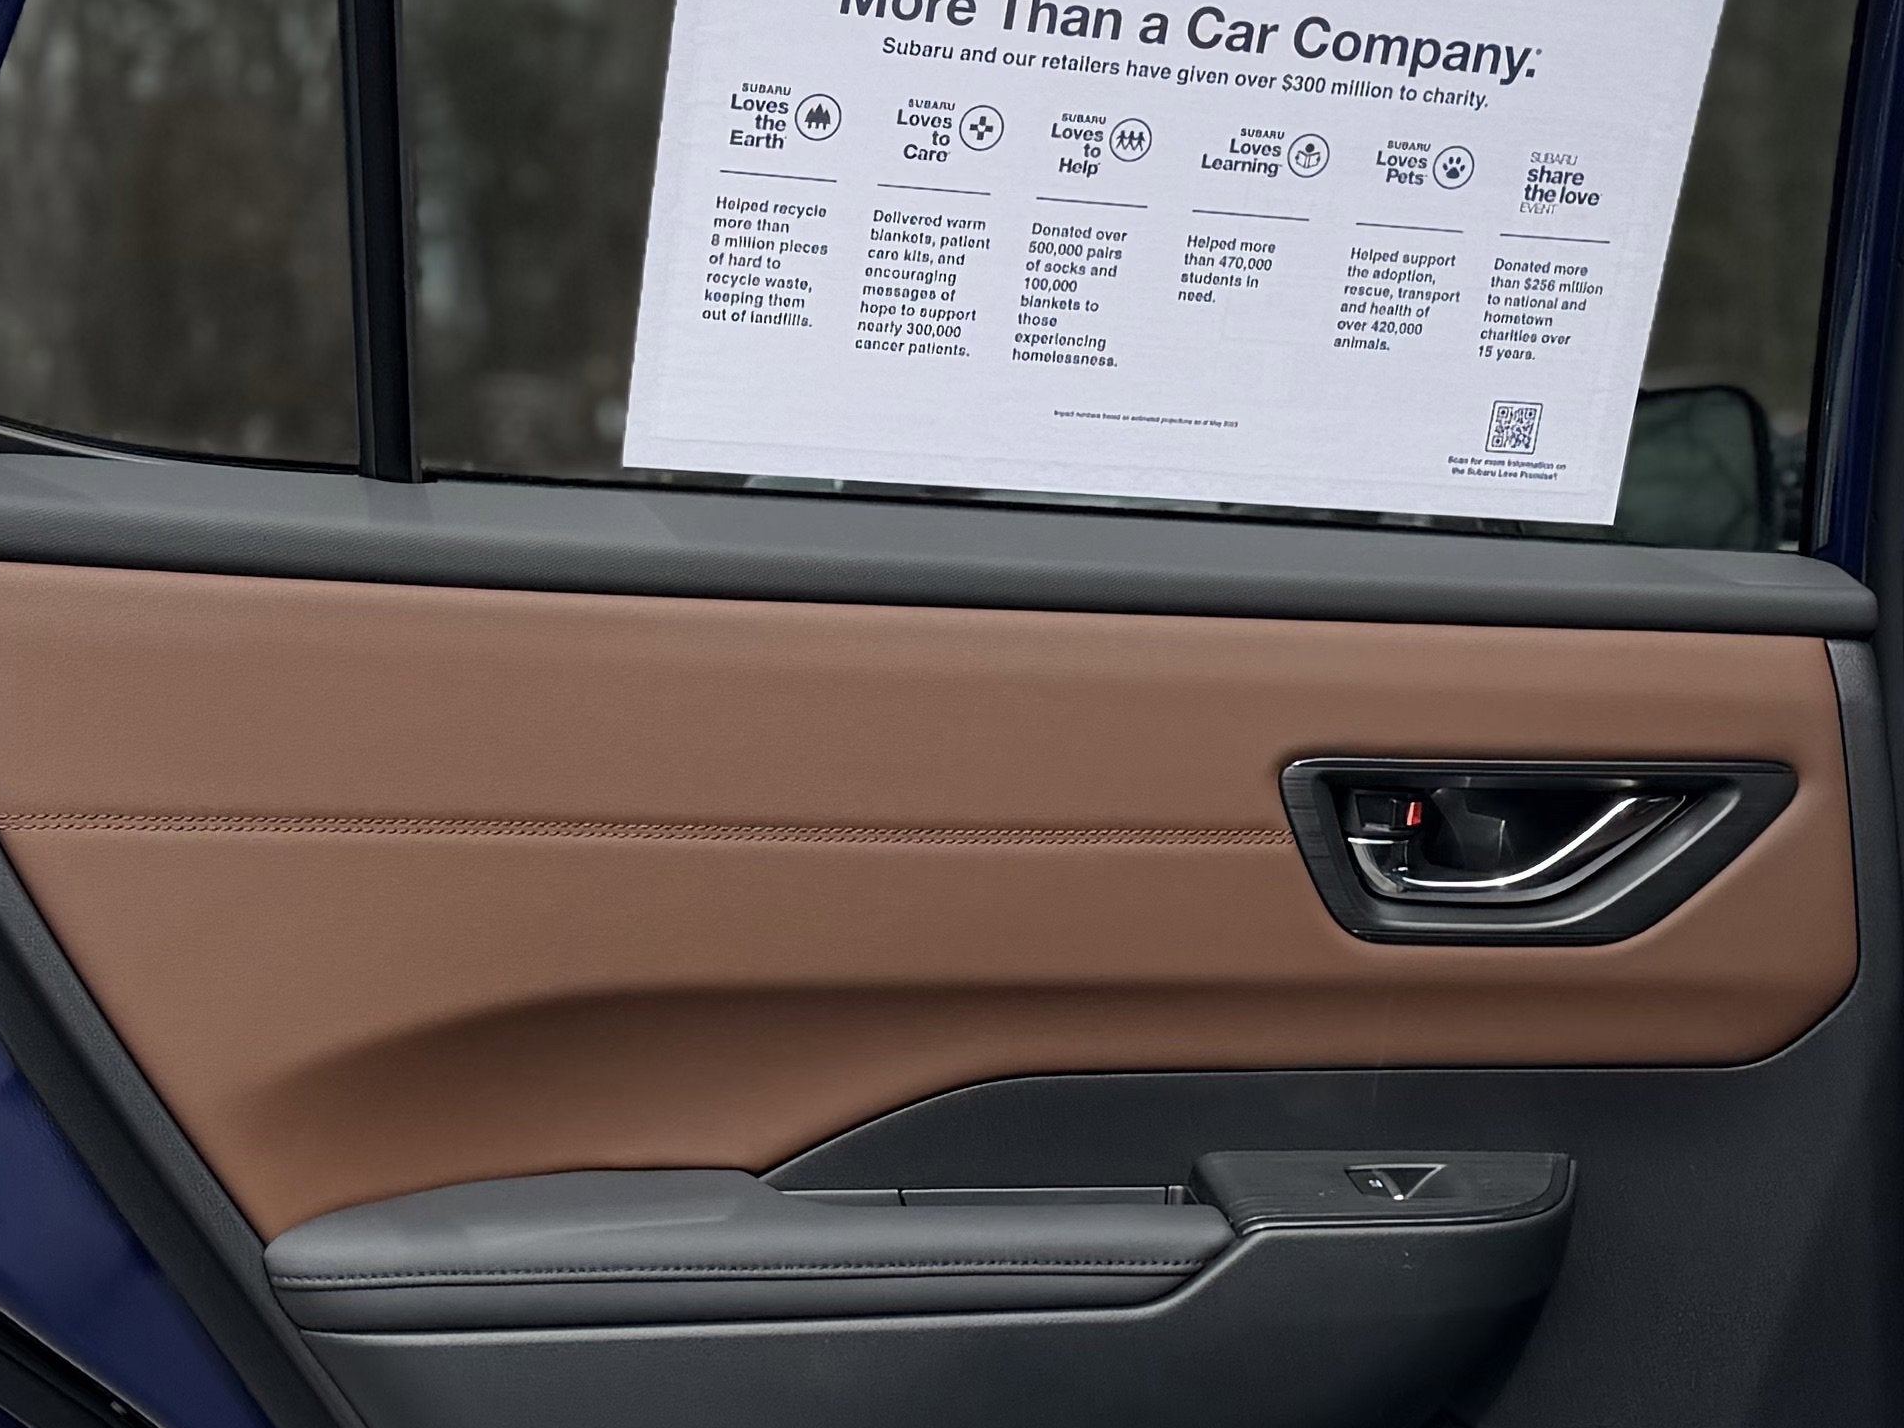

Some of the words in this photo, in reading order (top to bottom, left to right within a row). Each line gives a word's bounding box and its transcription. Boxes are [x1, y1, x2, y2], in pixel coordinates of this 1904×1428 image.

[1137, 11, 1169, 46] a
[1186, 5, 1280, 55] Car
[1292, 15, 1543, 86] Company.
[881, 35, 954, 60] Subaru
[958, 45, 998, 64] and
[1001, 51, 1037, 68] our
[1040, 53, 1120, 76] retailers
[1124, 58, 1172, 80] have
[1175, 63, 1229, 86] given
[1233, 72, 1278, 90] over
[1280, 72, 1327, 94] $300
[1329, 78, 1394, 100] million
[1398, 83, 1418, 102] to
[1421, 85, 1489, 112] charity.
[740, 81, 792, 97] SUBARU
[729, 92, 790, 115] Loves
[907, 97, 956, 112] SUBARU
[753, 112, 787, 133] the
[895, 107, 953, 130] Loves
[1060, 111, 1107, 126] SUBARU
[728, 128, 788, 151] Earth
[930, 129, 951, 147] to
[1049, 121, 1104, 143] Loves
[1239, 126, 1286, 141] SUBARU
[902, 142, 952, 163] Care
[1082, 142, 1102, 159] to
[1228, 136, 1282, 158] Loves
[1386, 138, 1432, 153] SUBARU
[1057, 156, 1102, 179] Help
[1200, 152, 1284, 179] Learning
[1374, 148, 1428, 170] Loves
[1529, 150, 1579, 167] SUBARU
[1384, 166, 1429, 186] Pets
[1525, 165, 1585, 187] share
[1523, 182, 1557, 204] the
[1557, 185, 1603, 207] love
[714, 194, 770, 215] Helped
[771, 202, 827, 220] recycle
[1518, 200, 1556, 215] EVENT
[712, 216, 753, 231] more
[756, 217, 790, 234] than
[871, 208, 943, 228] Delivered
[945, 217, 987, 232] warm
[869, 226, 936, 248] blankets,
[938, 234, 991, 251] patient
[1030, 221, 1093, 240] Donated
[1094, 229, 1129, 243] over
[709, 232, 721, 247] 8
[723, 234, 776, 251] million
[777, 238, 829, 256] pieces
[1027, 239, 1084, 258] 500,000
[1085, 245, 1123, 262] pairs
[1185, 233, 1238, 253] Helped
[1238, 240, 1277, 254] more
[707, 251, 725, 266] of
[727, 251, 763, 269] hard
[765, 255, 782, 270] to
[866, 247, 899, 262] care
[902, 247, 934, 266] kits,
[936, 252, 966, 266] and
[1183, 251, 1215, 268] than
[1217, 254, 1273, 272] 470,000
[1349, 245, 1400, 265] Helped
[1401, 252, 1457, 269] support
[1492, 256, 1552, 275] Donated
[1552, 263, 1589, 277] more
[863, 265, 957, 287] encouraging
[1024, 258, 1042, 273] of
[1042, 260, 1087, 276] socks
[1089, 263, 1118, 278] and
[1346, 264, 1370, 279] the
[1371, 266, 1436, 286] adoption,
[705, 271, 761, 289] recycle
[764, 276, 813, 294] waste,
[1023, 275, 1078, 294] 100,000
[1179, 270, 1242, 288] students
[1245, 273, 1260, 289] in
[1489, 274, 1521, 290] than
[1522, 276, 1556, 293] $256
[1557, 279, 1604, 296] million
[703, 287, 764, 309] keeping
[767, 292, 806, 309] them
[861, 284, 937, 303] messages
[939, 287, 957, 303] of
[1019, 293, 1081, 311] blankets
[1084, 298, 1100, 313] to
[1176, 289, 1216, 304] need.
[1342, 284, 1394, 301] rescue,
[1397, 286, 1461, 305] transport
[1486, 292, 1501, 306] to
[1503, 294, 1559, 310] national
[1559, 297, 1588, 312] and
[701, 307, 727, 322] out
[729, 308, 747, 323] of
[749, 309, 813, 328] landfills.
[858, 299, 897, 318] hope
[899, 302, 916, 317] to
[918, 306, 977, 322] support
[1016, 311, 1058, 328] those
[1339, 300, 1368, 314] and
[1368, 300, 1412, 318] health
[1414, 304, 1431, 319] of
[1482, 309, 1554, 328] hometown
[855, 319, 903, 338] nearly
[905, 321, 962, 339] 300,000
[1335, 319, 1368, 332] over
[1369, 319, 1423, 336] 420,000
[1479, 326, 1538, 344] charities
[1540, 333, 1572, 346] over
[854, 338, 906, 353] cancer
[906, 341, 971, 358] patients.
[1013, 331, 1107, 353] experiencing
[1332, 334, 1391, 352] animals.
[1011, 346, 1118, 368] homelessness.
[1477, 344, 1494, 358] 15
[1495, 347, 1536, 362] years.
